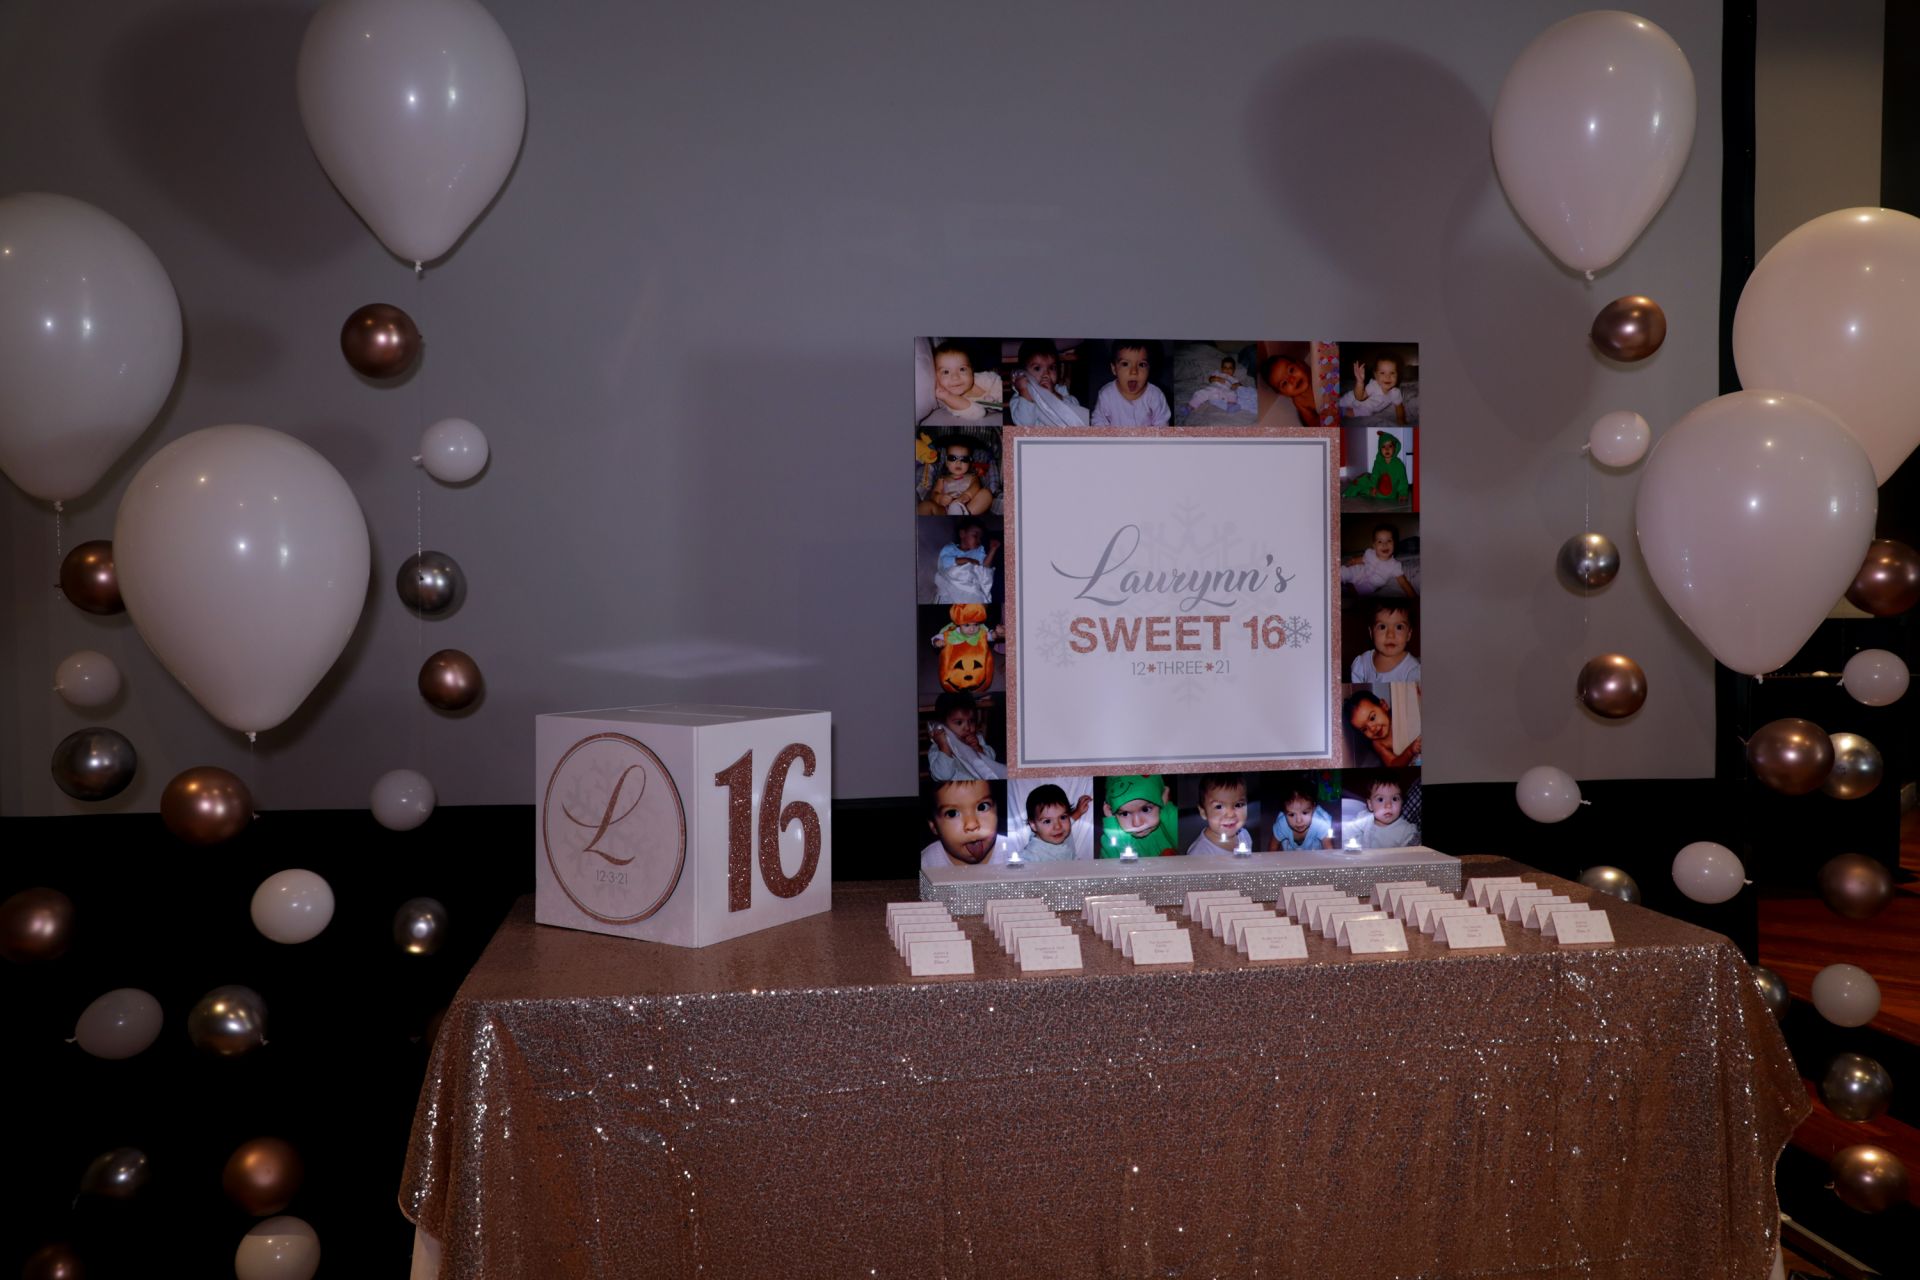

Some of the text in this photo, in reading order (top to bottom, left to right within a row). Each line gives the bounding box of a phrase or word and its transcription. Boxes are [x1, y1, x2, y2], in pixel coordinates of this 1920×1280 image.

[1050, 524, 1296, 612] Laurynn's
[1069, 615, 1286, 653] SWEET 16
[561, 765, 647, 866] L
[714, 742, 822, 912] 16
